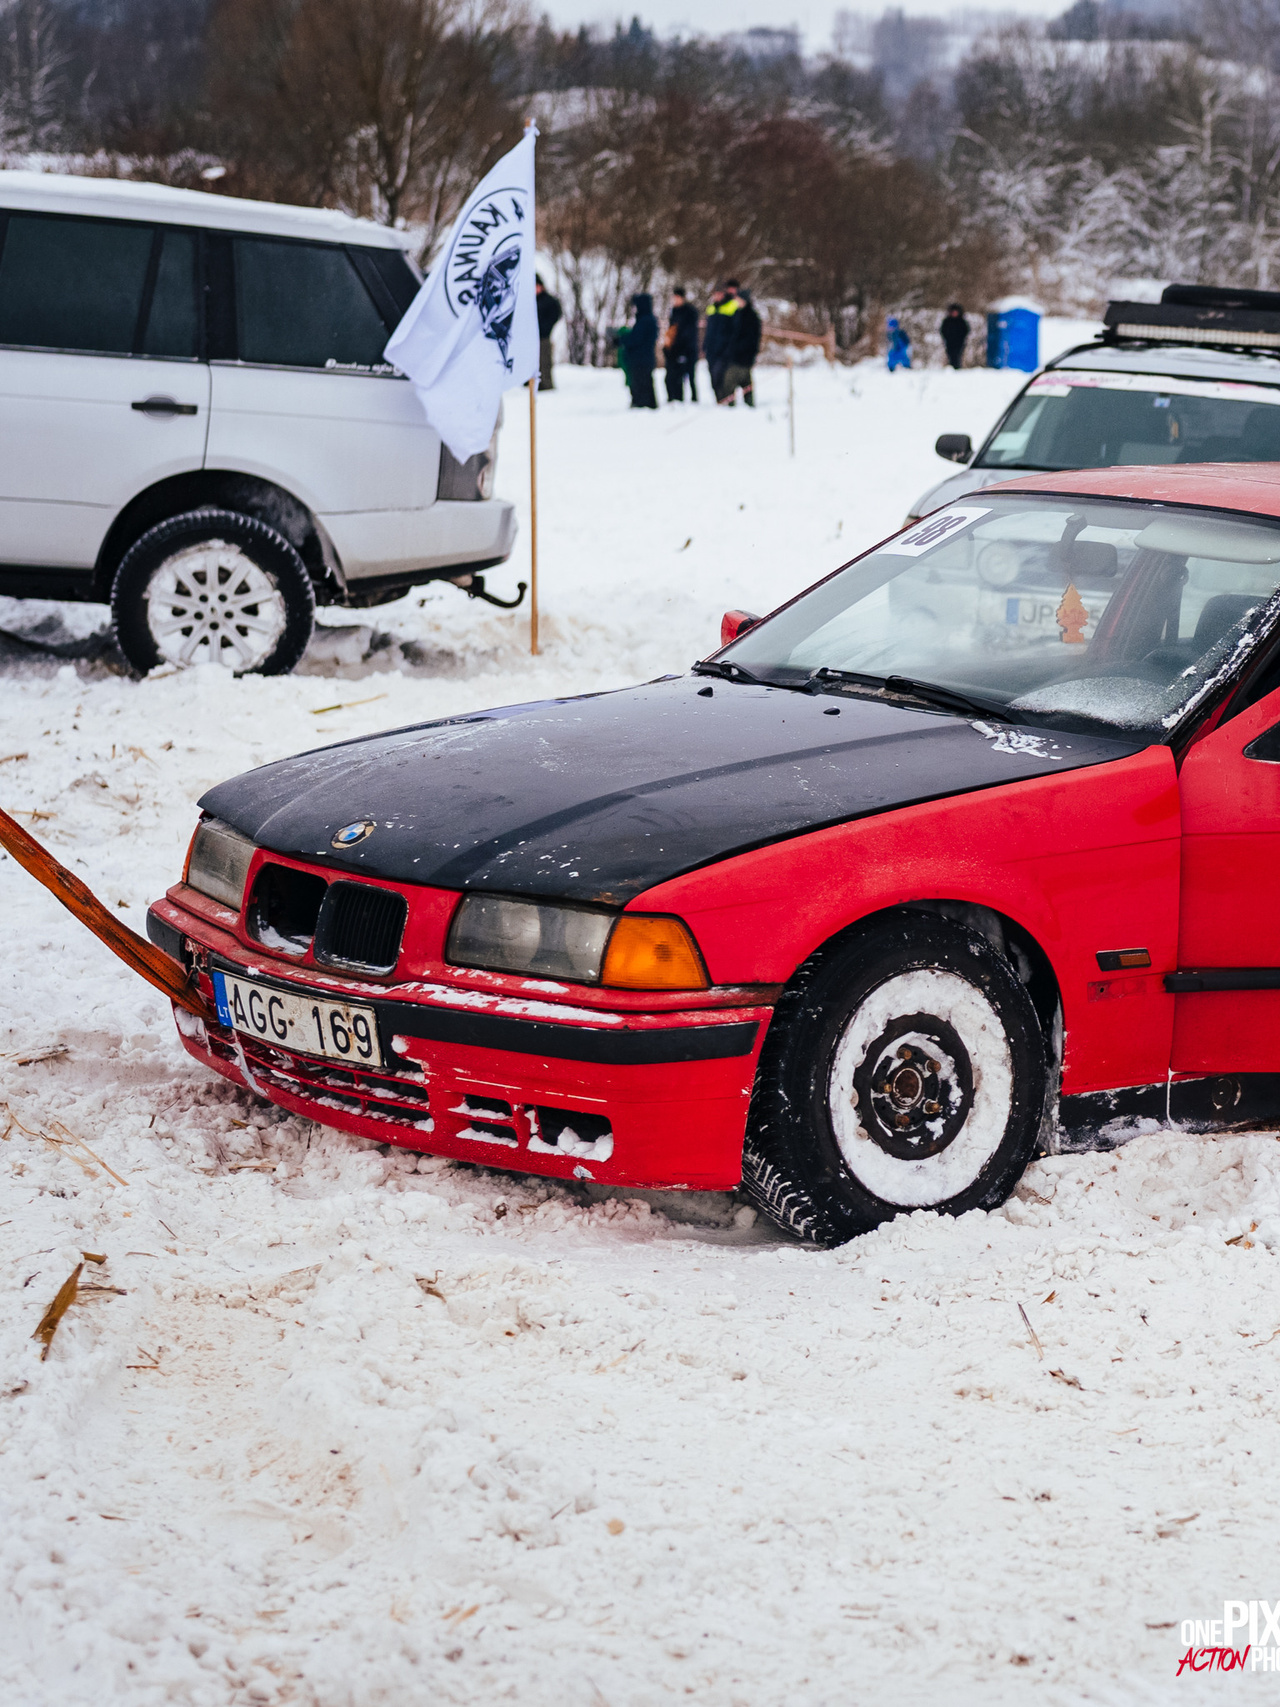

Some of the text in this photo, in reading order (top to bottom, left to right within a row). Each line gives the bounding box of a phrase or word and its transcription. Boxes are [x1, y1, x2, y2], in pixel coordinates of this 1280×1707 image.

[901, 515, 967, 546] 98
[217, 1006, 230, 1019] LT
[233, 983, 373, 1059] AGG 169
